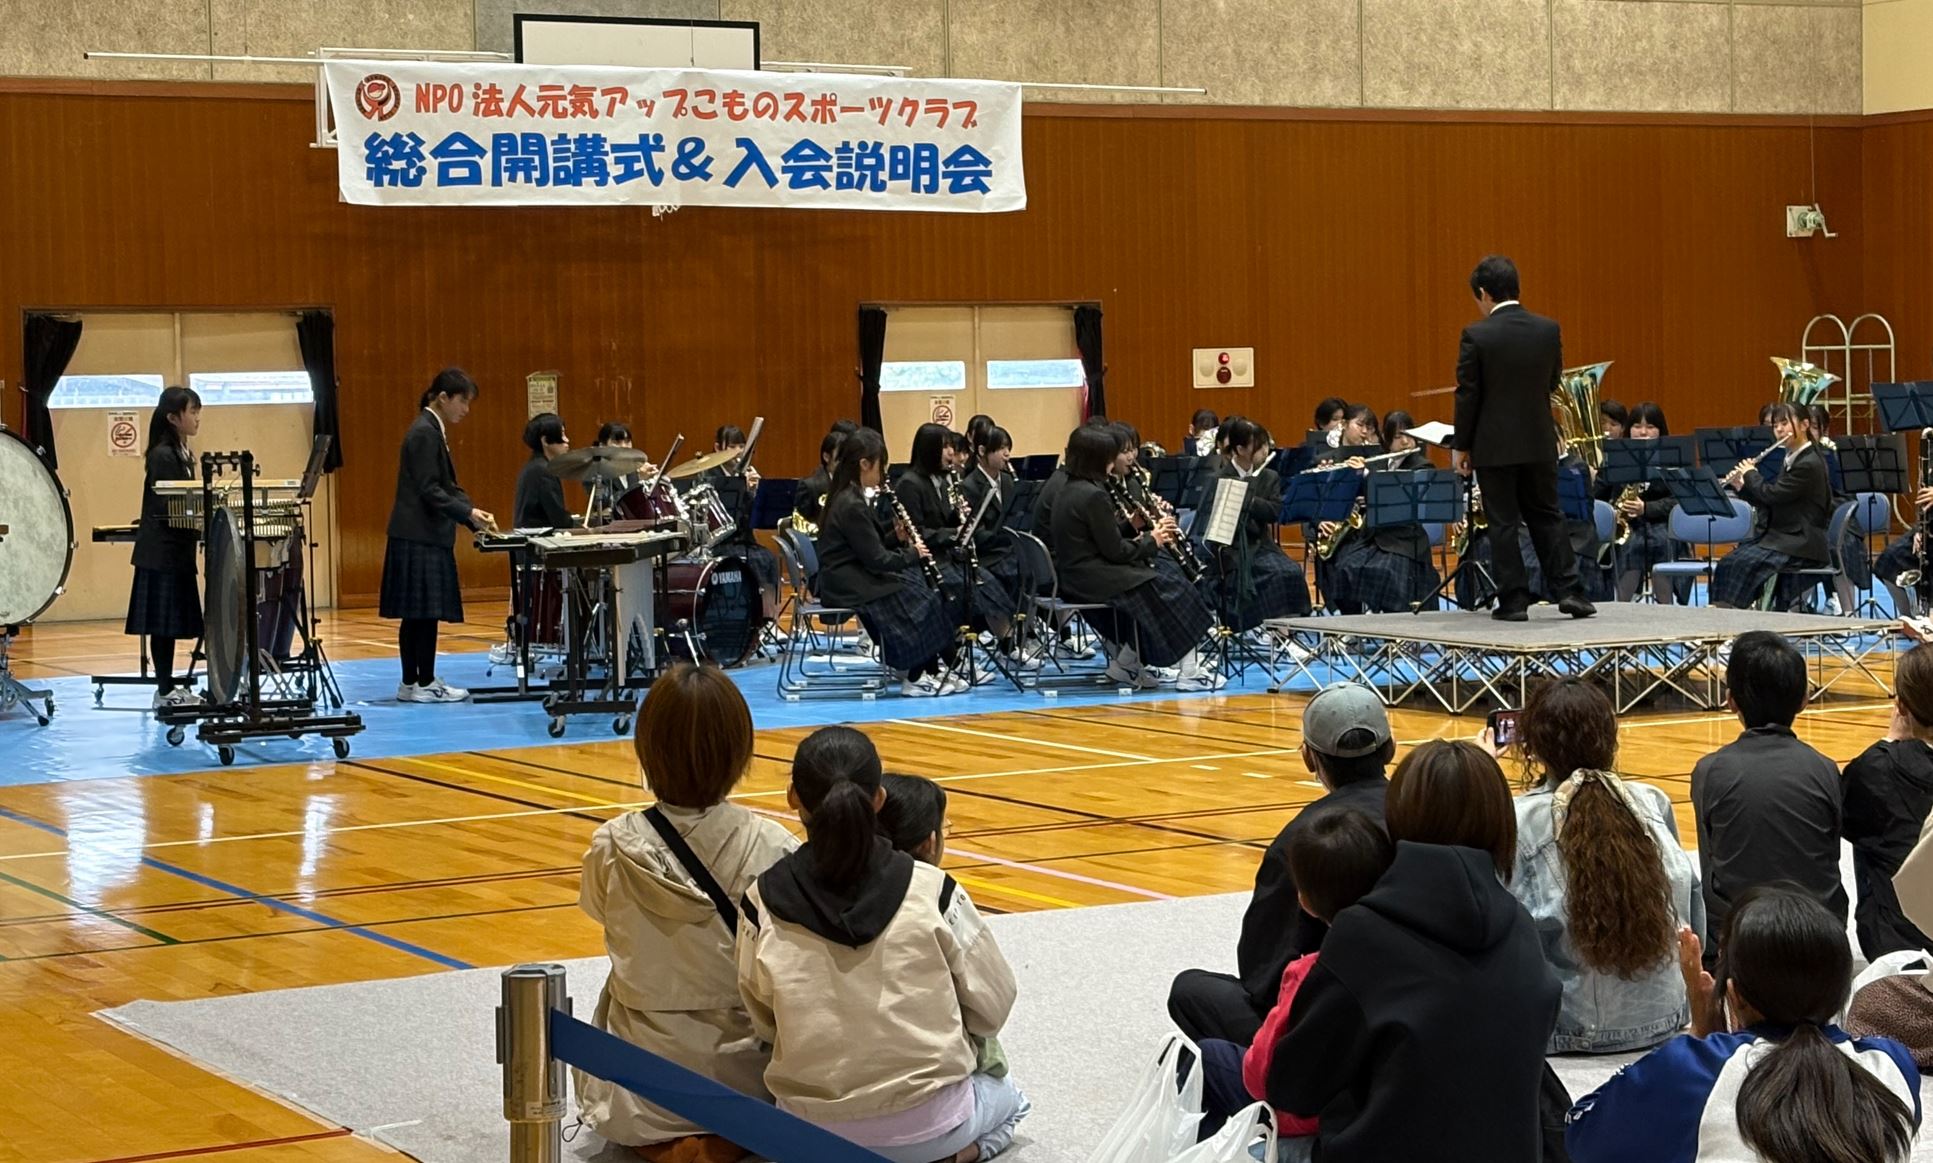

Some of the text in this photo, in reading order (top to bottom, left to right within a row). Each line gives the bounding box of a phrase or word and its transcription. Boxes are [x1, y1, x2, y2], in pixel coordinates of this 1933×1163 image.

[415, 83, 464, 113] NPO
[472, 82, 978, 129] 法人元気アップこものスポーツクラブ
